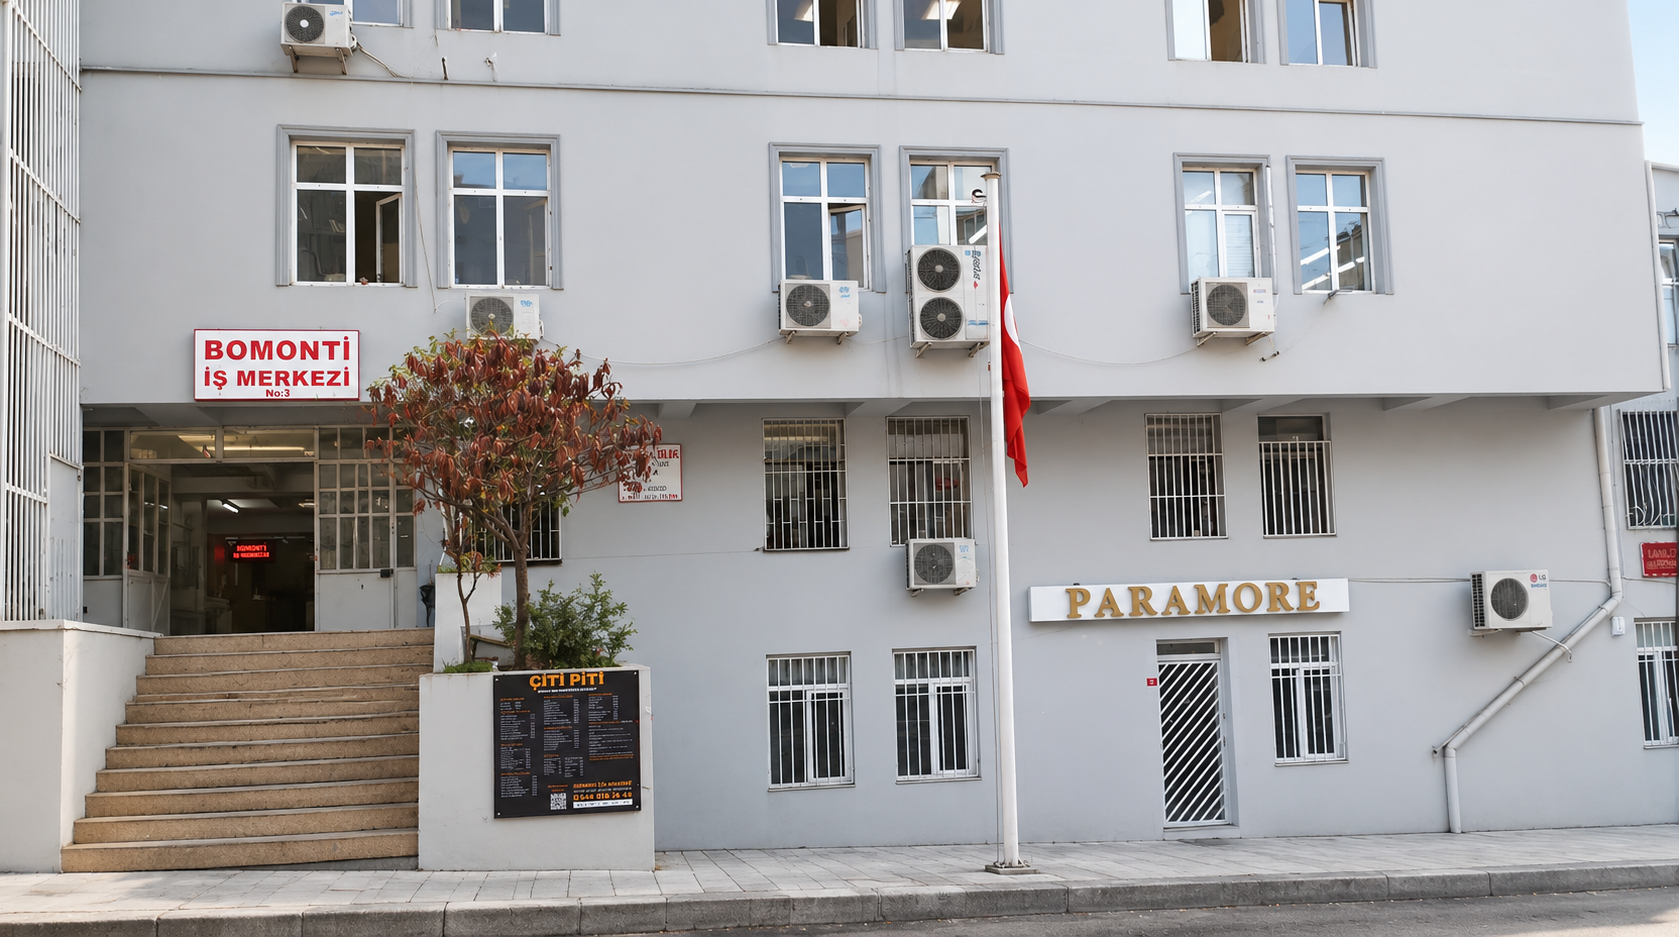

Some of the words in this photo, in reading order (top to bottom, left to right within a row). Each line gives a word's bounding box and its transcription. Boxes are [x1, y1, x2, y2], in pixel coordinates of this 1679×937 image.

[204, 336, 350, 360] BOMONTİ
[204, 366, 228, 390] İŞ
[237, 366, 350, 387] MERKEZİ
[265, 389, 290, 398] No:3
[1065, 581, 1320, 619] PARAMORE
[529, 672, 565, 691] ÇİTİ
[569, 670, 605, 686] PİTİ
